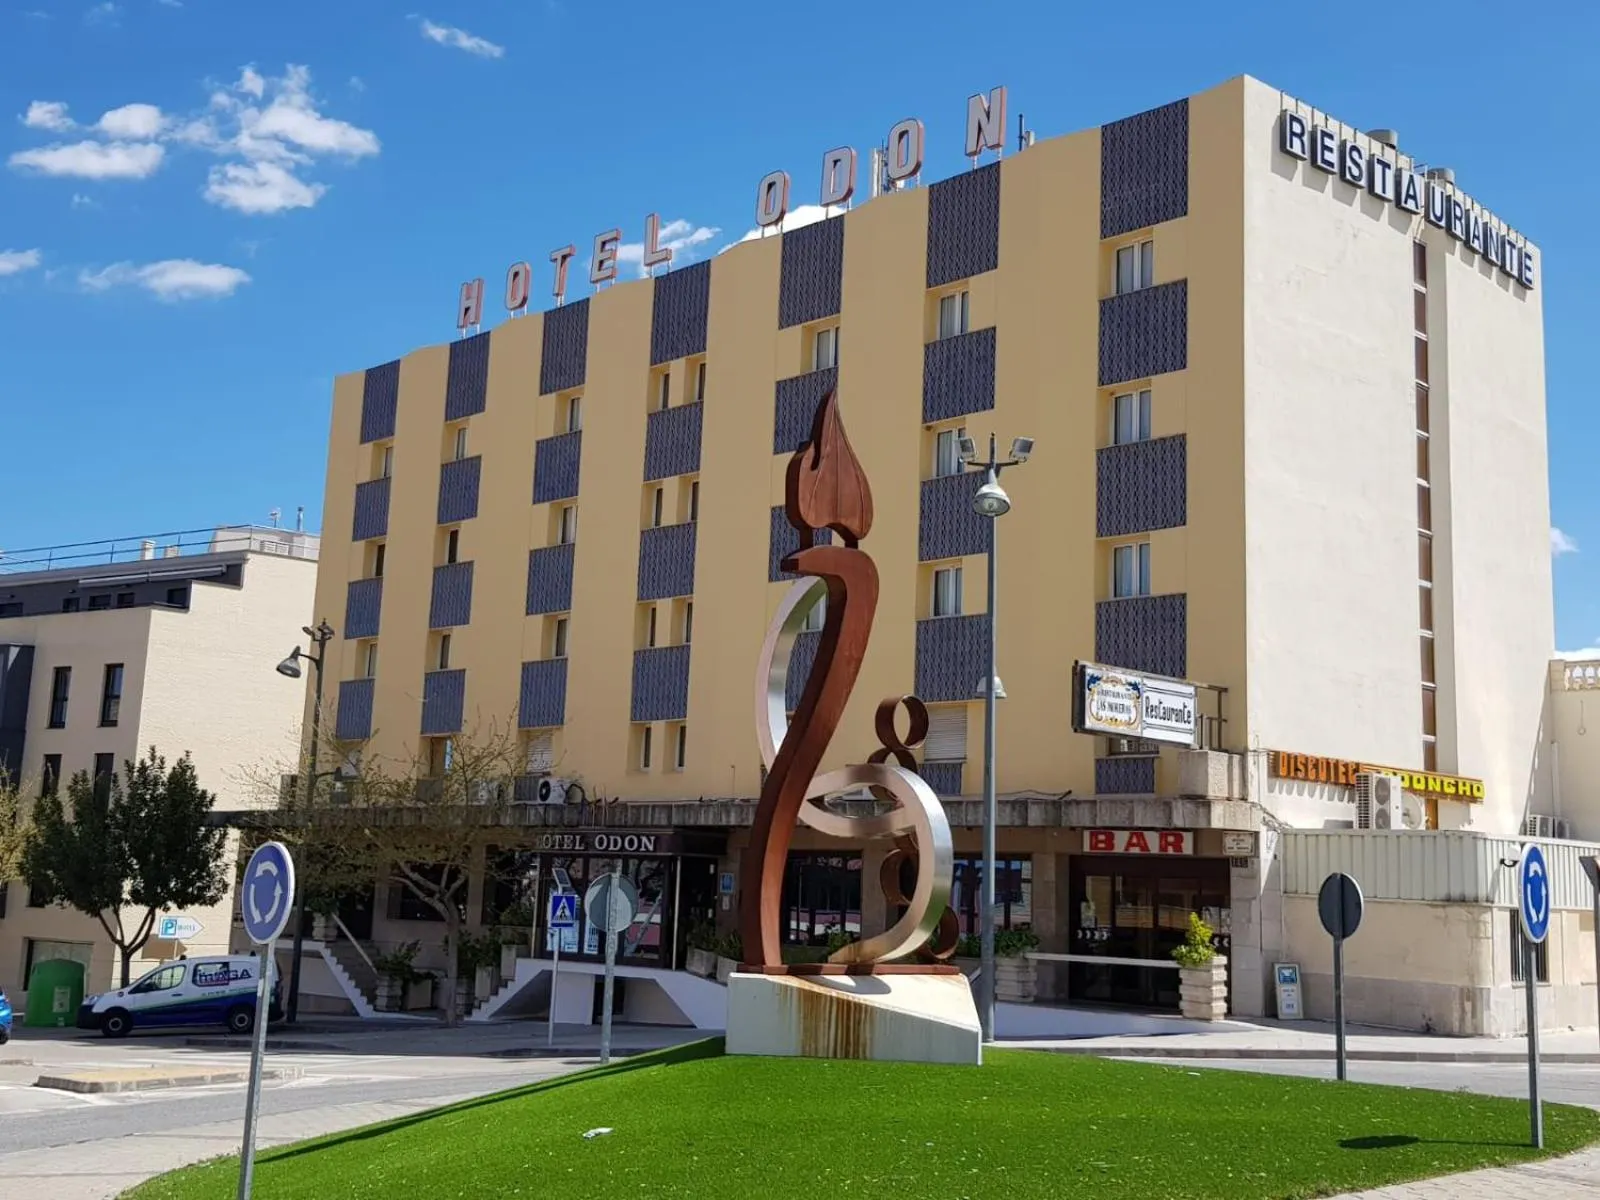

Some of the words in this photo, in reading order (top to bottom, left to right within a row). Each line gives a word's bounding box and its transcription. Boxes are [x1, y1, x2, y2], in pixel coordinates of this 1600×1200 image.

[456, 212, 672, 329] HOTEL
[754, 84, 1007, 227] ODON
[1287, 113, 1534, 286] RESTAURANTE
[1145, 696, 1191, 724] Restaurante
[1279, 751, 1356, 785] DISCOTEC
[595, 834, 655, 851] ODON
[1089, 830, 1185, 853] BAR
